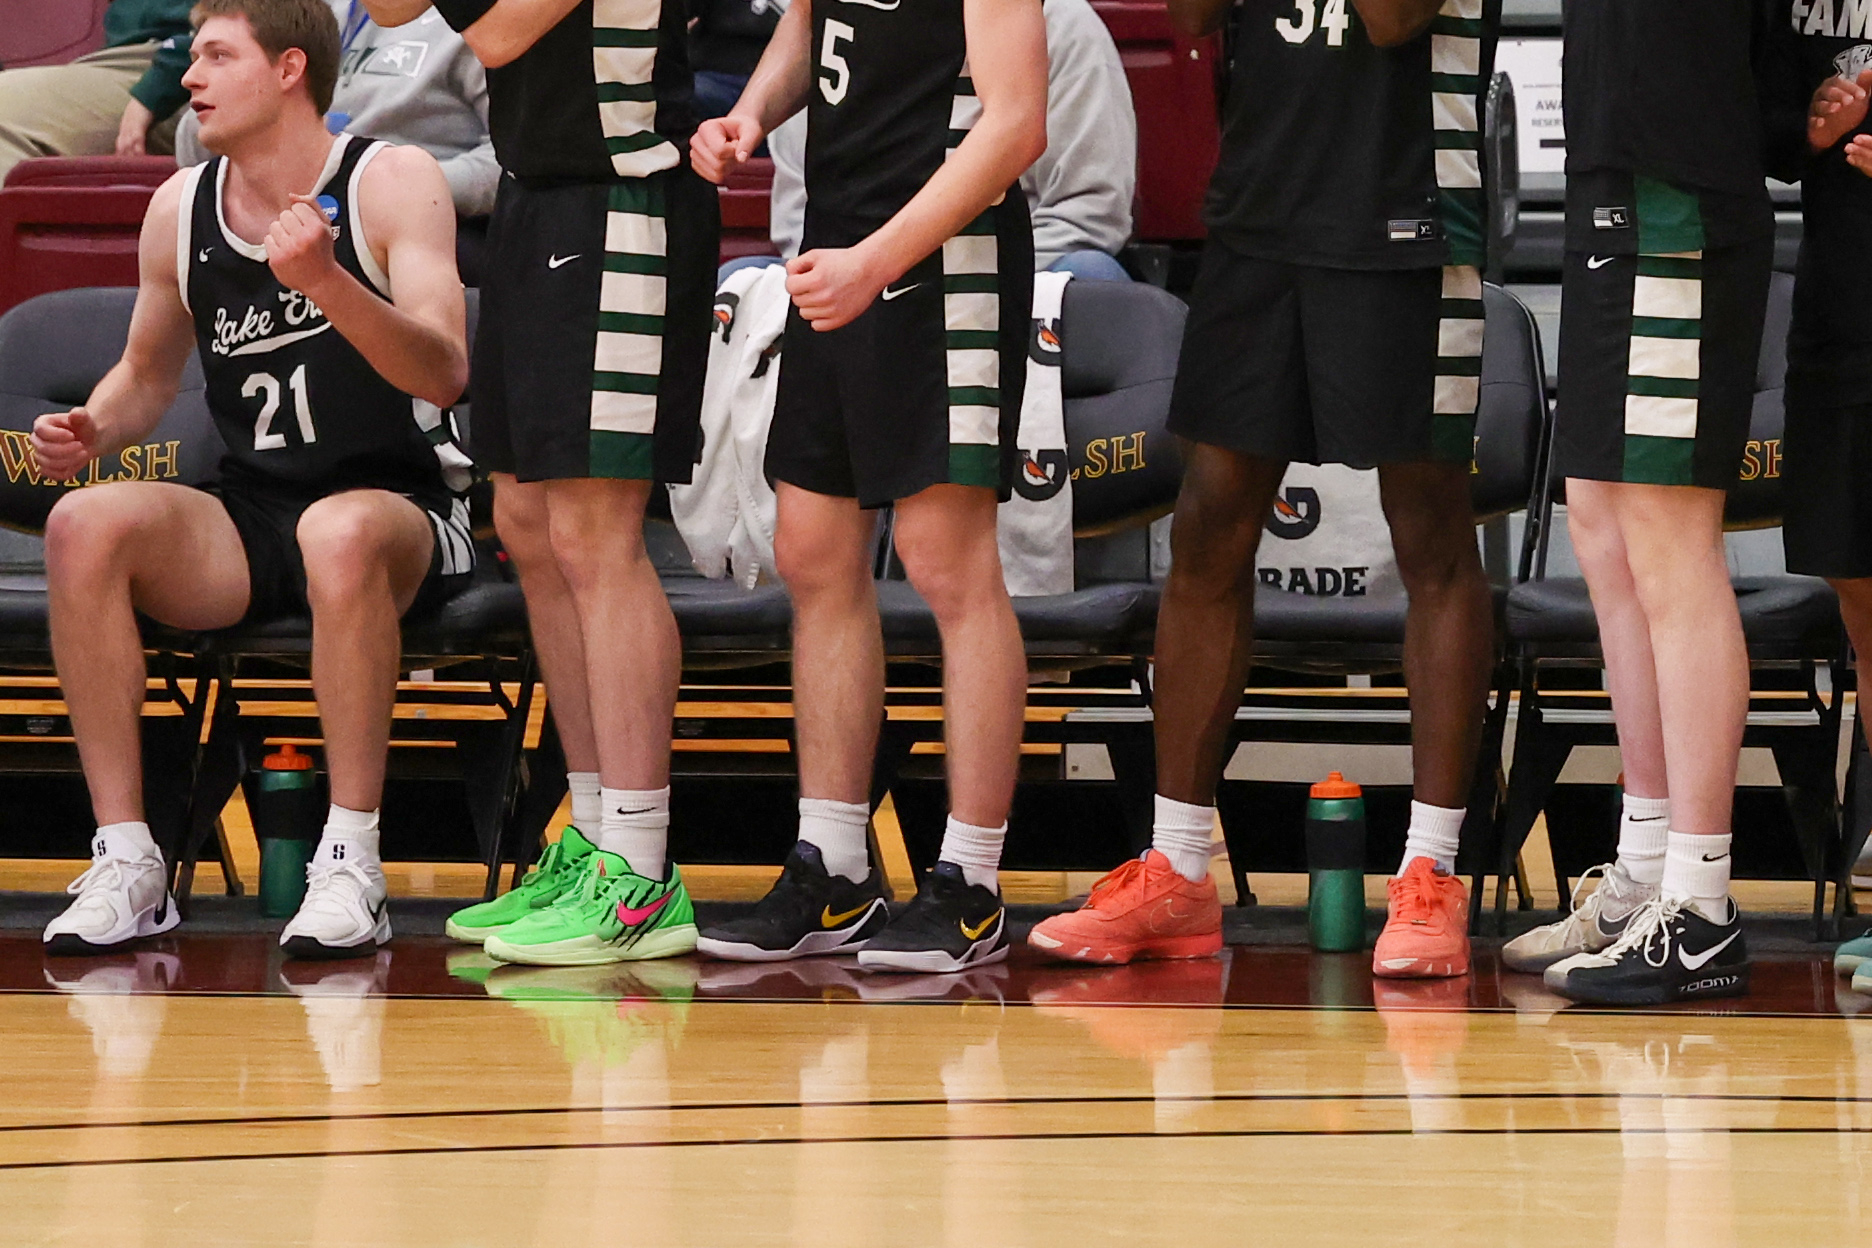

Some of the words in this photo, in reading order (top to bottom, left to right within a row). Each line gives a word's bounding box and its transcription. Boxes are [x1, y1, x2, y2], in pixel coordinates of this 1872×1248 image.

[819, 17, 855, 106] 5
[1613, 212, 1625, 224] XL
[212, 305, 275, 355] Lake
[241, 363, 316, 451] 21
[0, 429, 181, 487] WLSH
